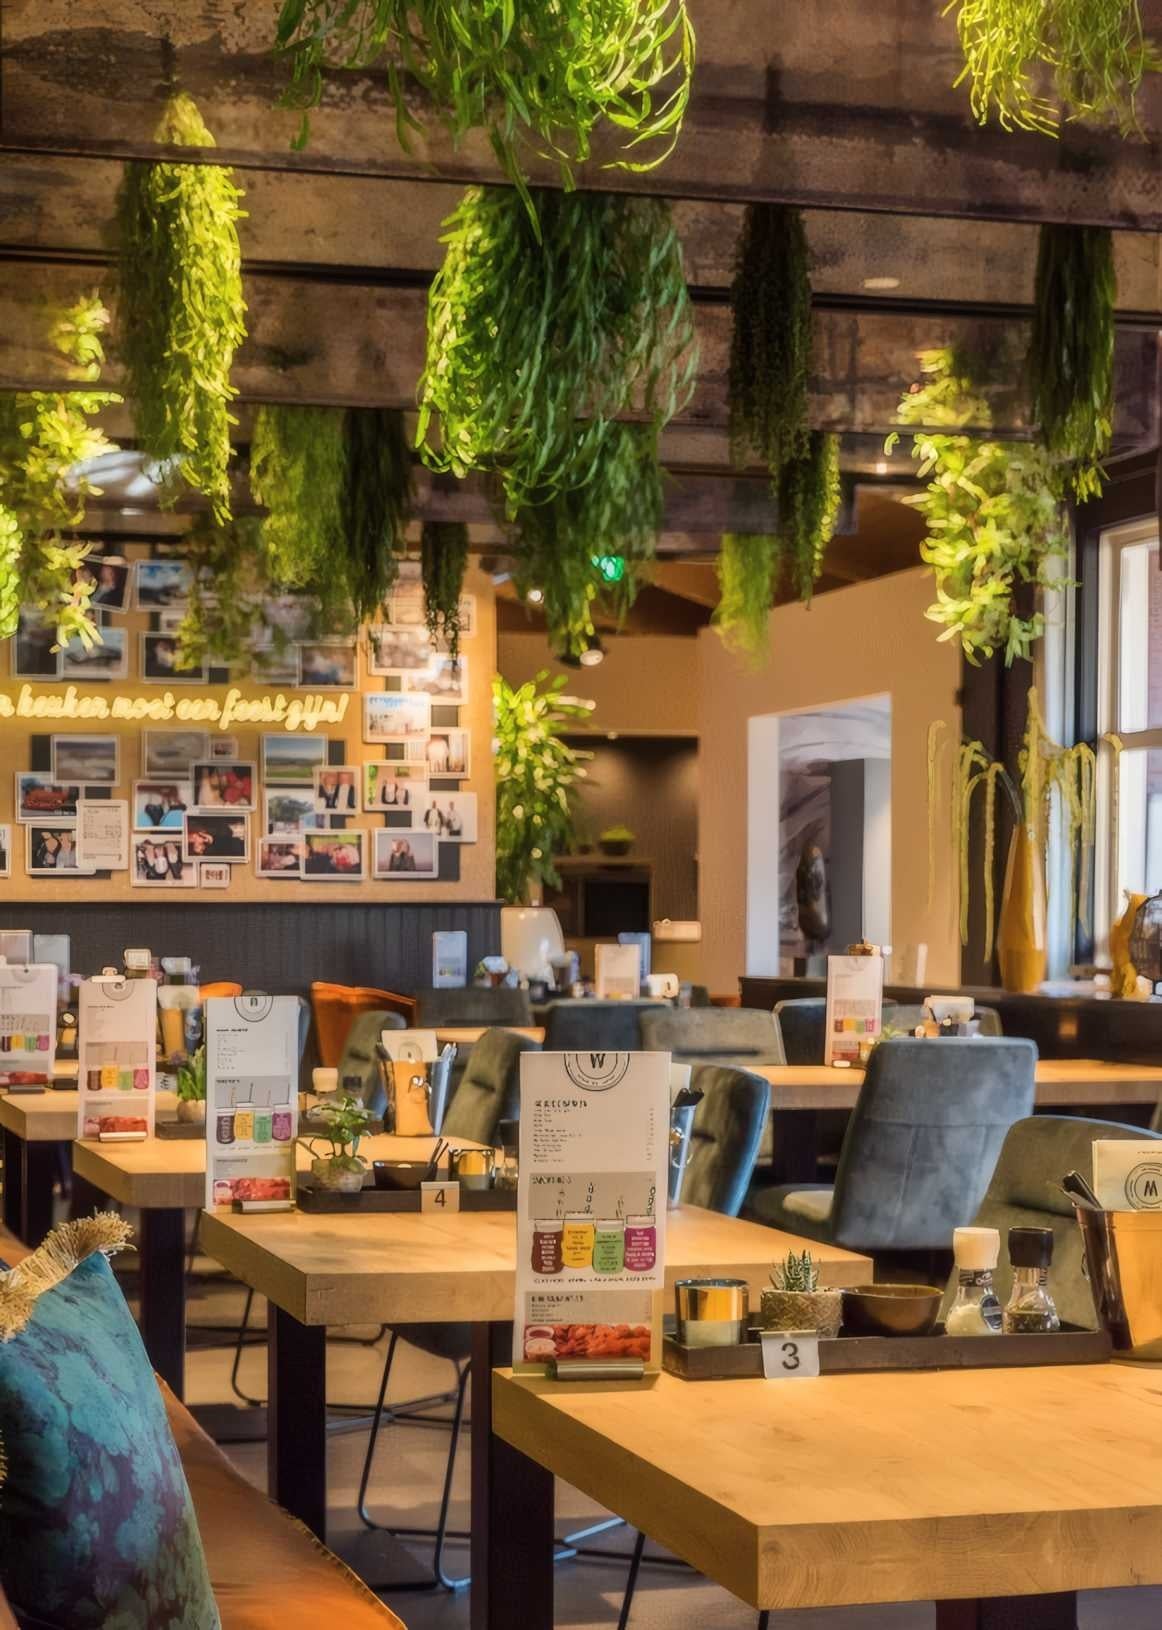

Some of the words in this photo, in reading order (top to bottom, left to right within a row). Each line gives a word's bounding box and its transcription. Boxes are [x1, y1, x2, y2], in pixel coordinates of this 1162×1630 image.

[111, 692, 175, 720] moet
[176, 698, 221, 721] een
[434, 1189, 448, 1208] 4
[781, 1342, 800, 1370] 3
